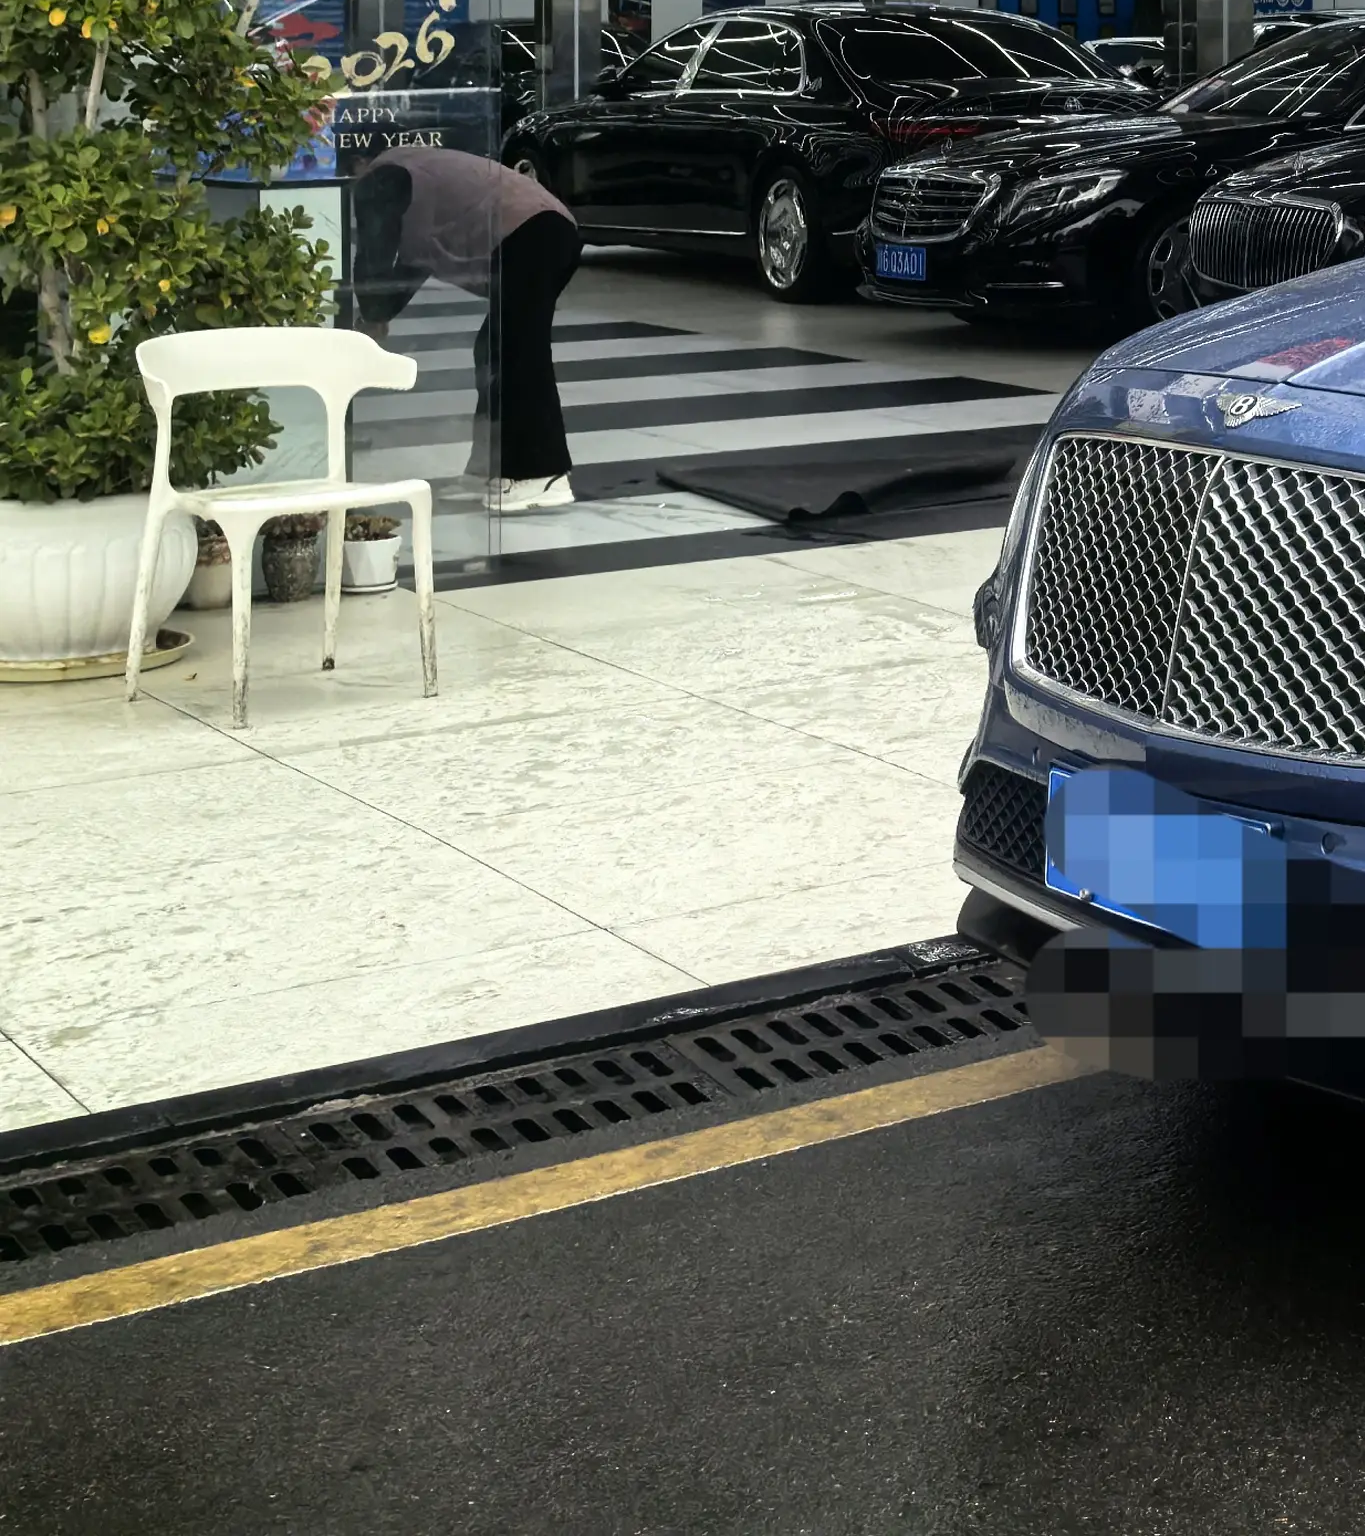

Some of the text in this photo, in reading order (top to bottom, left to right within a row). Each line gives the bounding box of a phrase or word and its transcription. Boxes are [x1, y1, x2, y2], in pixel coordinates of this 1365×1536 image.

[321, 107, 400, 124] HAPPY
[320, 130, 444, 149] NEW YEAR
